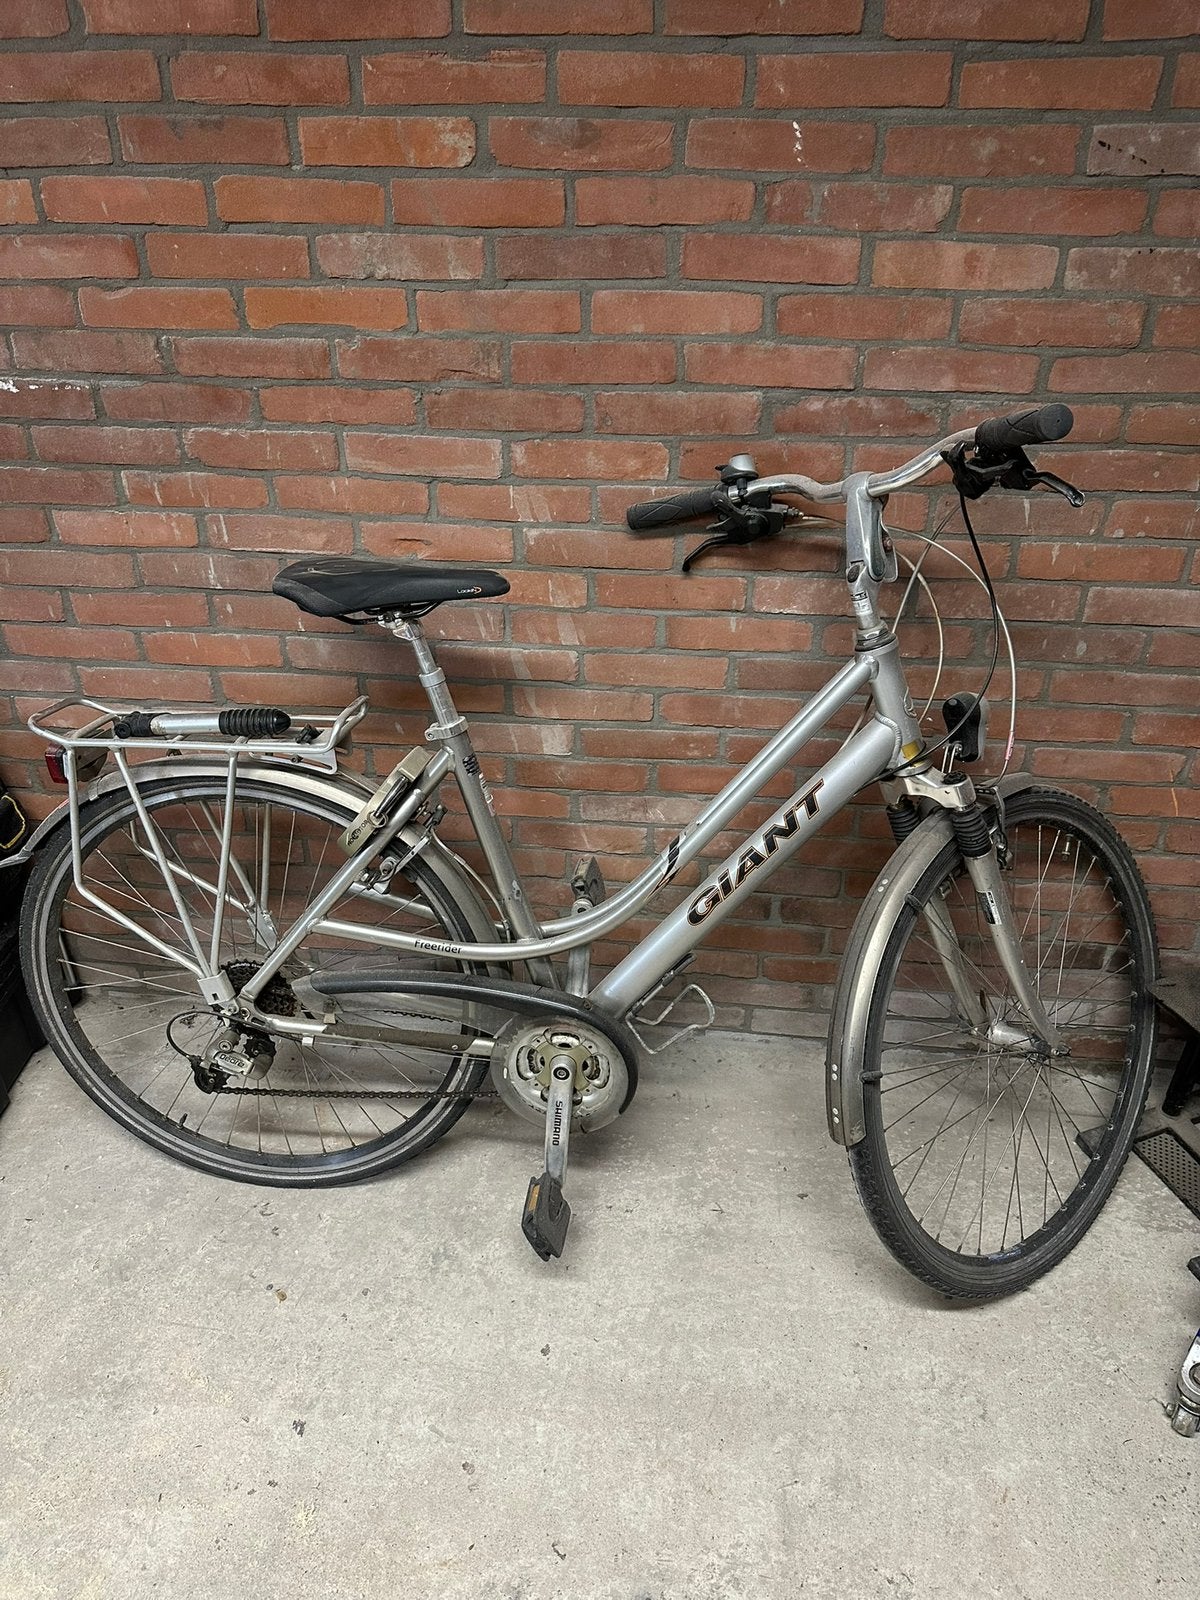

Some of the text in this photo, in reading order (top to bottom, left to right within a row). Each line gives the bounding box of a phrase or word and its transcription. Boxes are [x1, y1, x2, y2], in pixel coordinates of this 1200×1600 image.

[687, 778, 825, 926] GIANT
[414, 940, 462, 954] Freerider
[552, 1101, 564, 1146] SHIMANO
